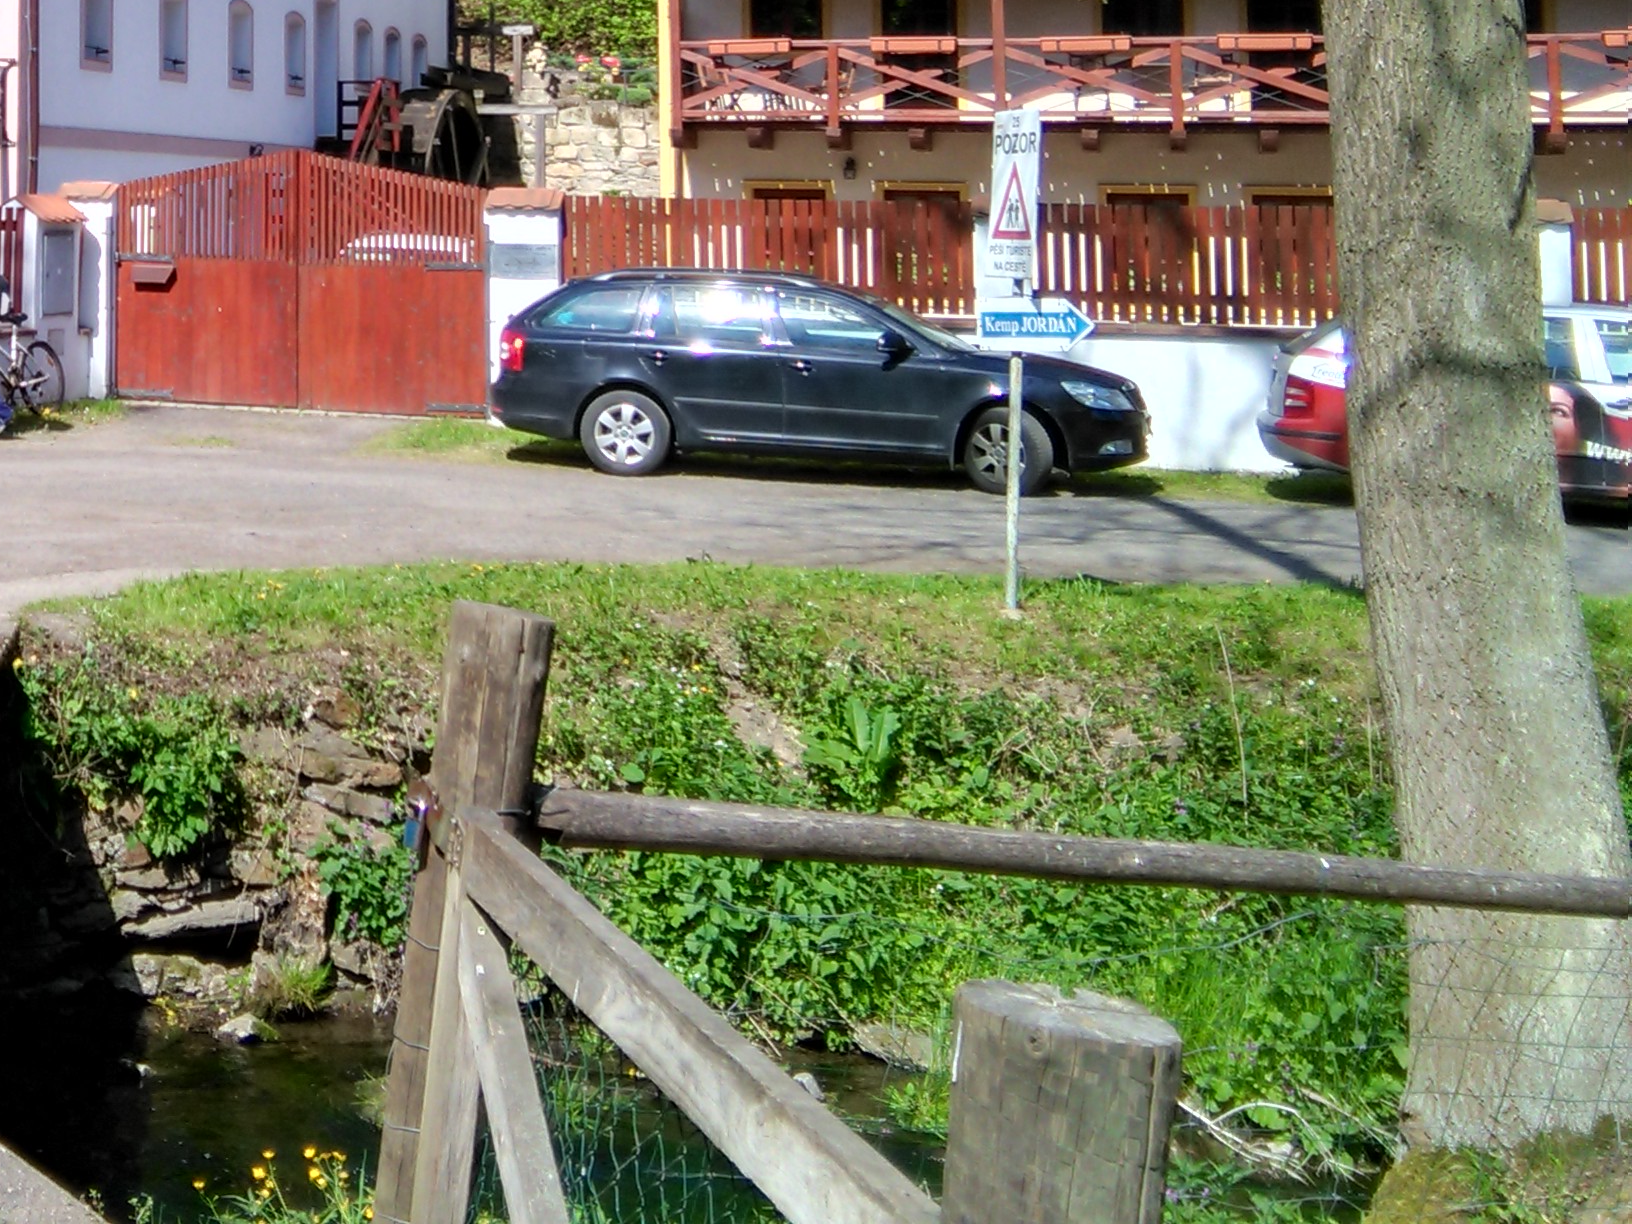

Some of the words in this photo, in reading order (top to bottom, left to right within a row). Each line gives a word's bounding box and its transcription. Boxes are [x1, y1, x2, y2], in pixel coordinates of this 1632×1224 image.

[995, 131, 1037, 155] POZOR
[984, 316, 1020, 337] Kemp
[1021, 313, 1078, 334] JORDÁN
